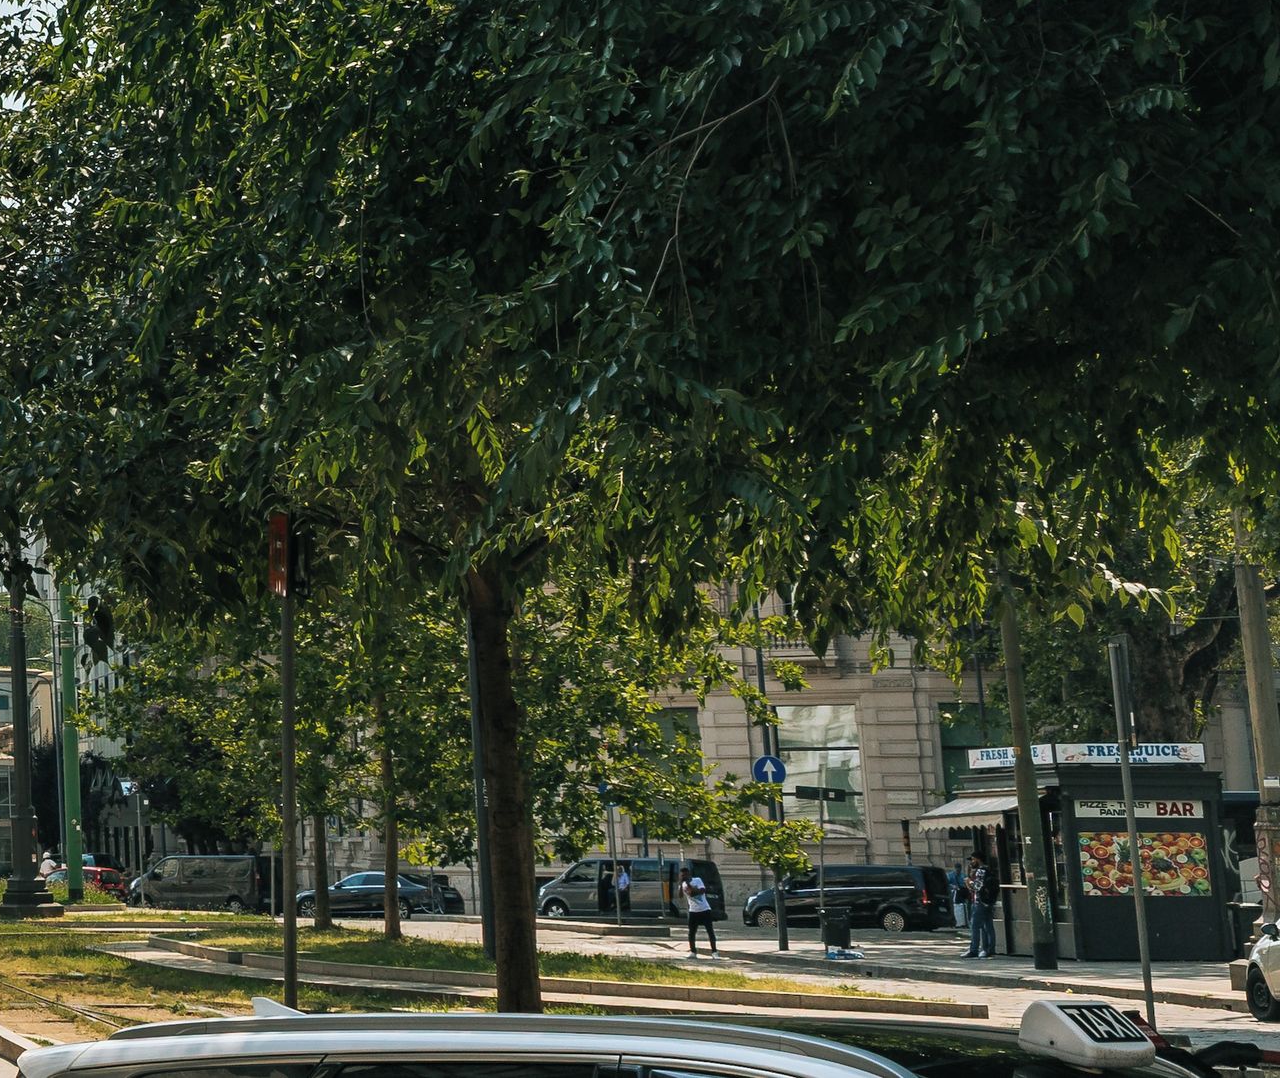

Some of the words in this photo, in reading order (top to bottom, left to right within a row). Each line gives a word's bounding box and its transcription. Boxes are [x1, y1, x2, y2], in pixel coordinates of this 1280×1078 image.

[980, 749, 1009, 761] FRESH
[1087, 745, 1135, 756] FRES
[1136, 745, 1180, 757] JUICE
[1080, 801, 1108, 809] PIZZE
[1119, 801, 1151, 809] TAST
[1156, 802, 1195, 817] BAR
[1062, 1008, 1141, 1038] TAXI
